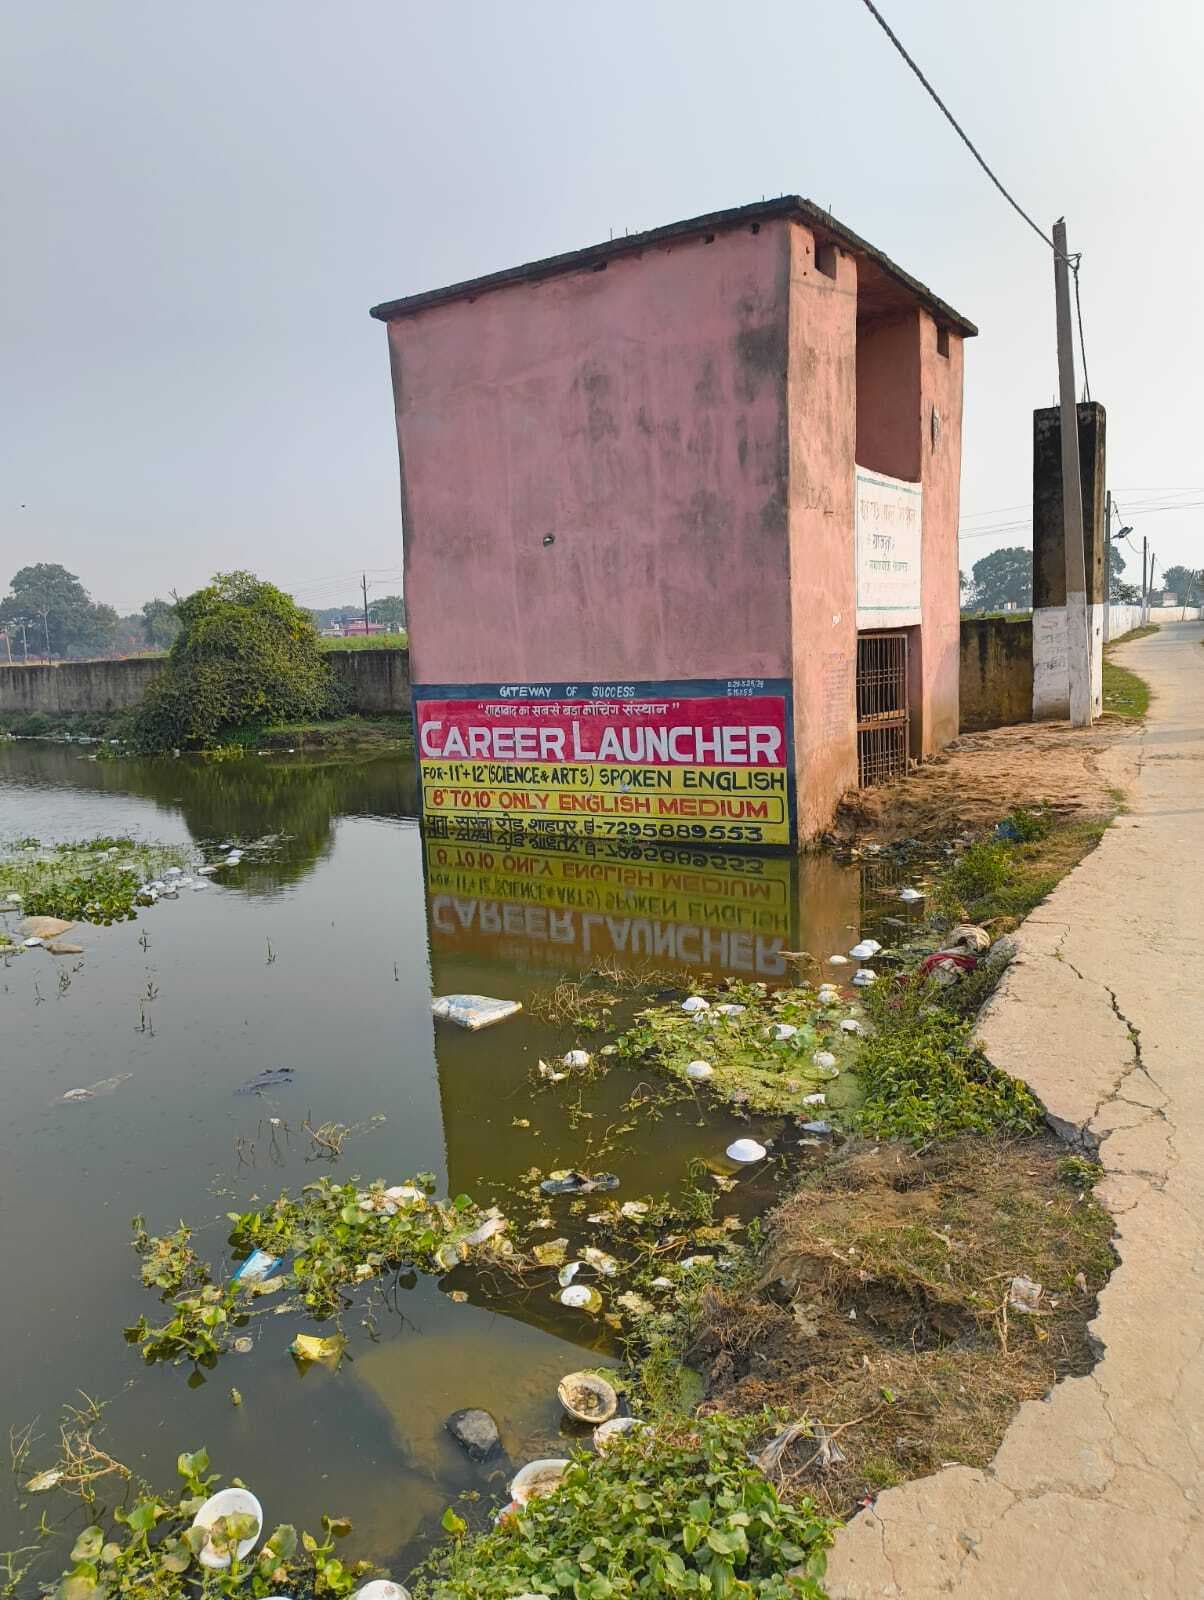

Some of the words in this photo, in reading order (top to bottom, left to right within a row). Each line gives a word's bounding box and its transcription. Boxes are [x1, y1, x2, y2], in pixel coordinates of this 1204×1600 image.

[499, 686, 552, 698] GATEWAY
[566, 686, 579, 697] OF
[592, 686, 635, 698] SUCCESS
[518, 705, 530, 716] का
[532, 702, 561, 717] सबसे
[420, 720, 566, 761] CAREER
[572, 720, 782, 764] LAUNCHER
[599, 768, 672, 789] SPOKEN
[683, 770, 785, 792] ENGLISH
[498, 792, 550, 810] ONLY
[558, 794, 651, 813] ENGLISH
[658, 797, 769, 819] MEDIUM
